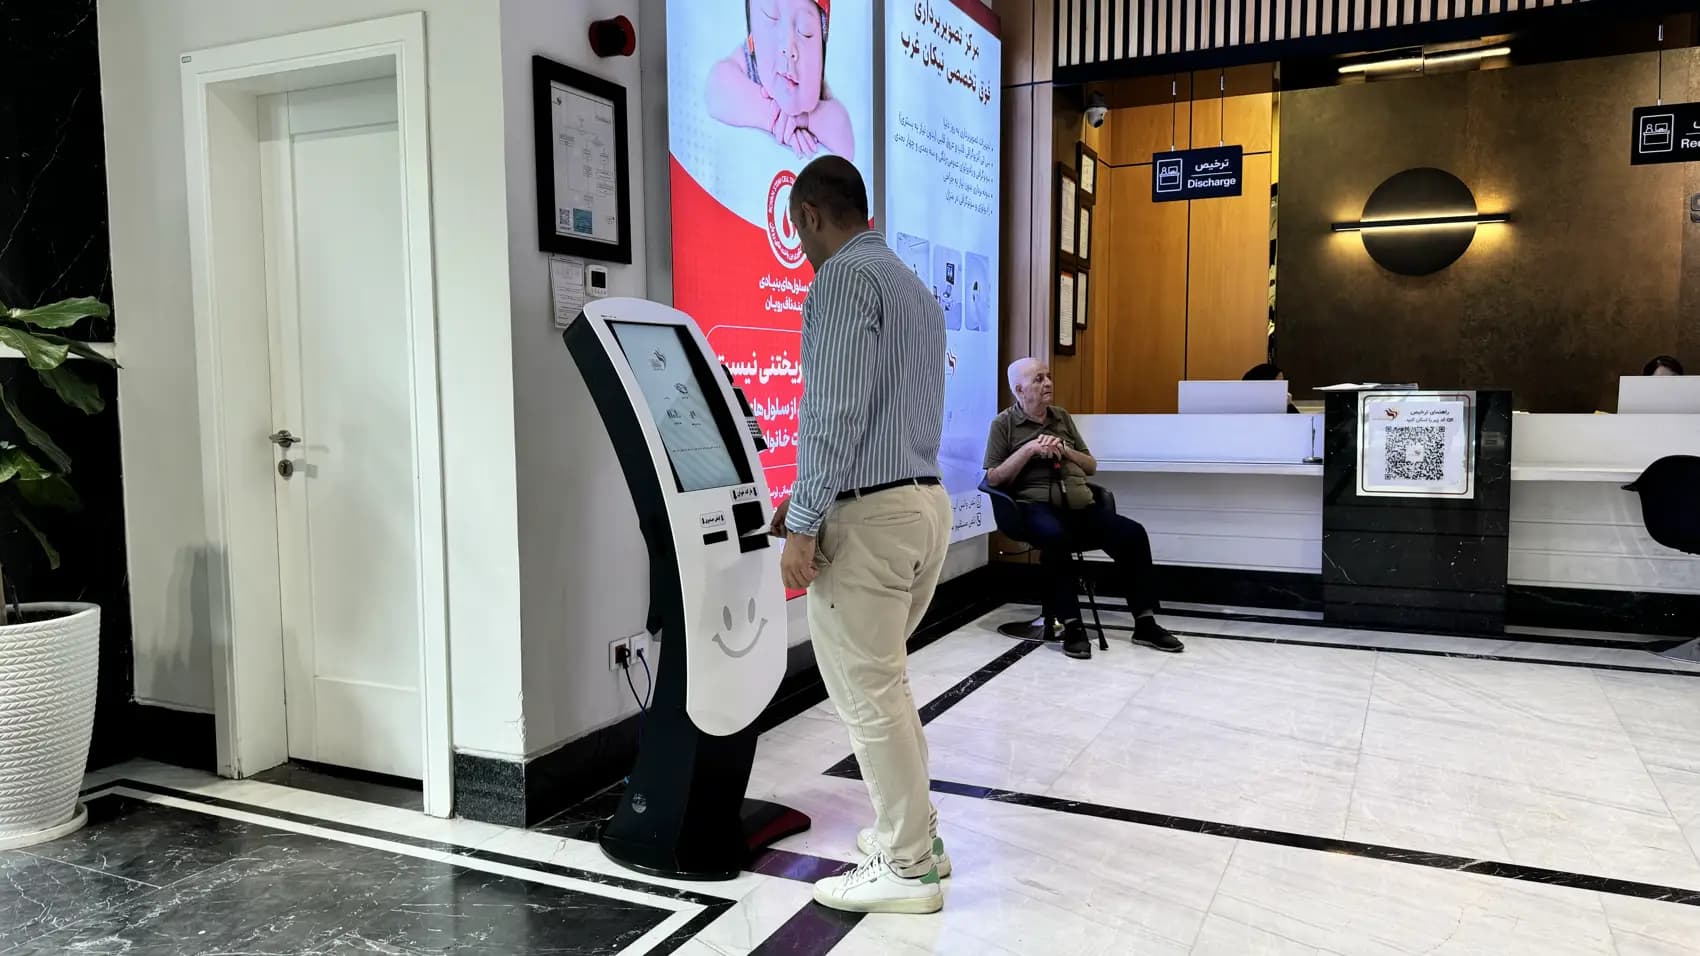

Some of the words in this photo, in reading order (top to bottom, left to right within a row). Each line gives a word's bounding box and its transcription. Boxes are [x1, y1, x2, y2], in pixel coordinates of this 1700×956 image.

[901, 31, 920, 58] غرب
[965, 33, 980, 61] مرکز
[923, 42, 945, 77] نیکان
[947, 67, 977, 92] تخصصی
[979, 80, 991, 105] فوق
[1194, 158, 1230, 172] ترخیص
[1187, 177, 1237, 188] Discharge
[759, 273, 781, 292] بنیادی
[765, 295, 783, 313] رویان
